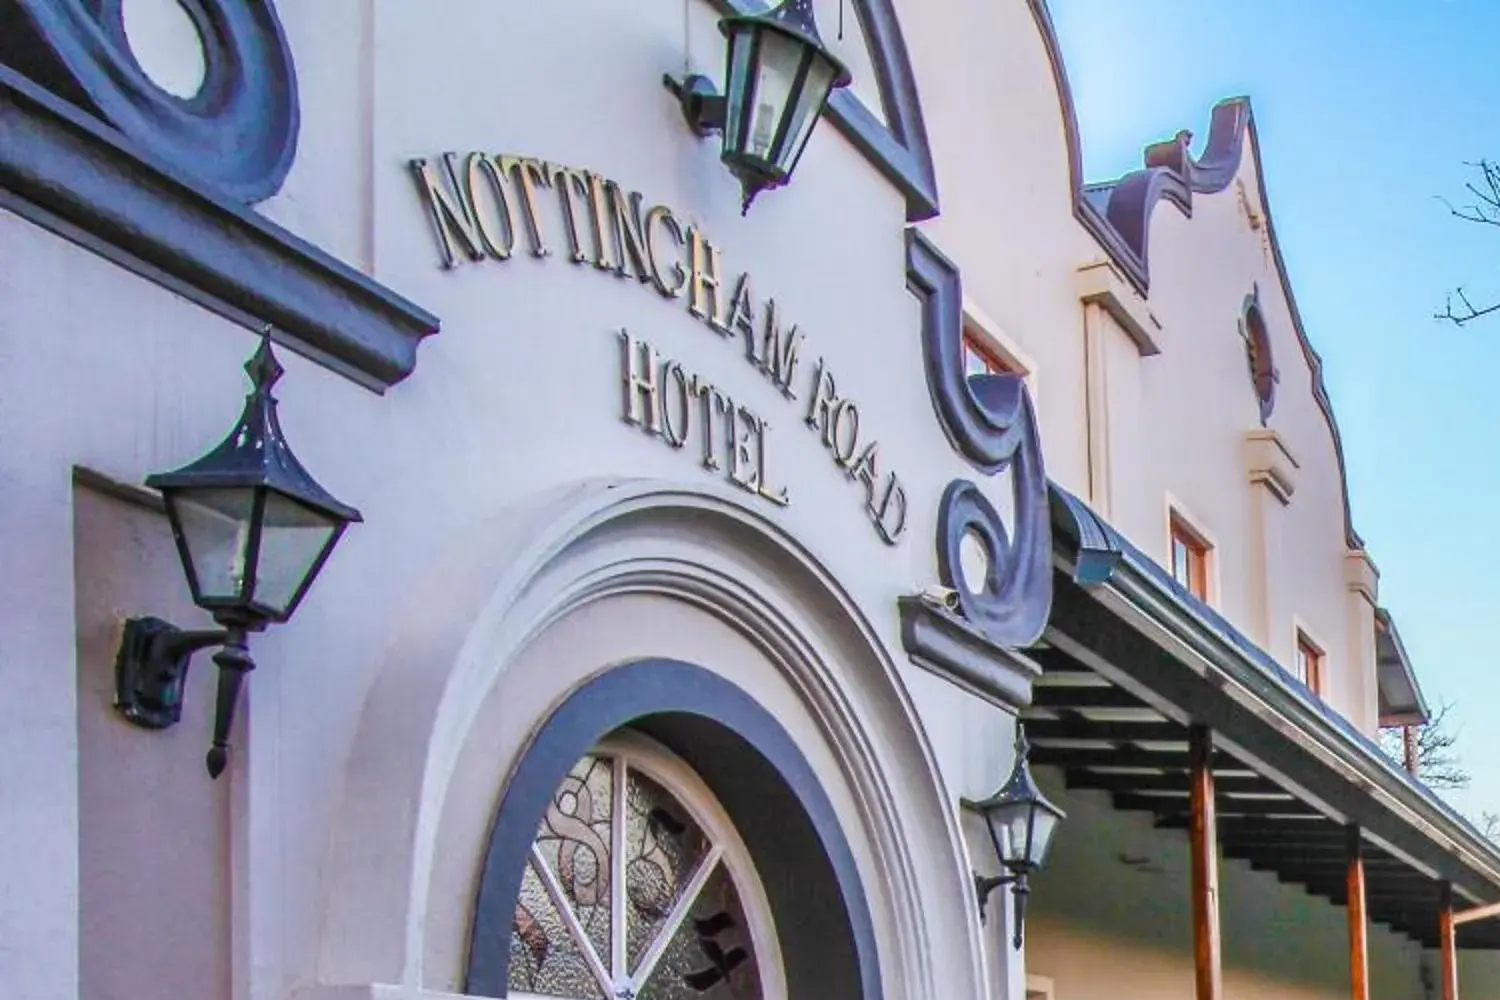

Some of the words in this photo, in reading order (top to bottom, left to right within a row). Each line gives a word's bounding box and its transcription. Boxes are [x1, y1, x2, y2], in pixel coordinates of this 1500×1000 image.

[405, 150, 804, 401] NOTTINGHAM
[804, 357, 907, 547] ROAD
[616, 328, 790, 507] HOTEL
